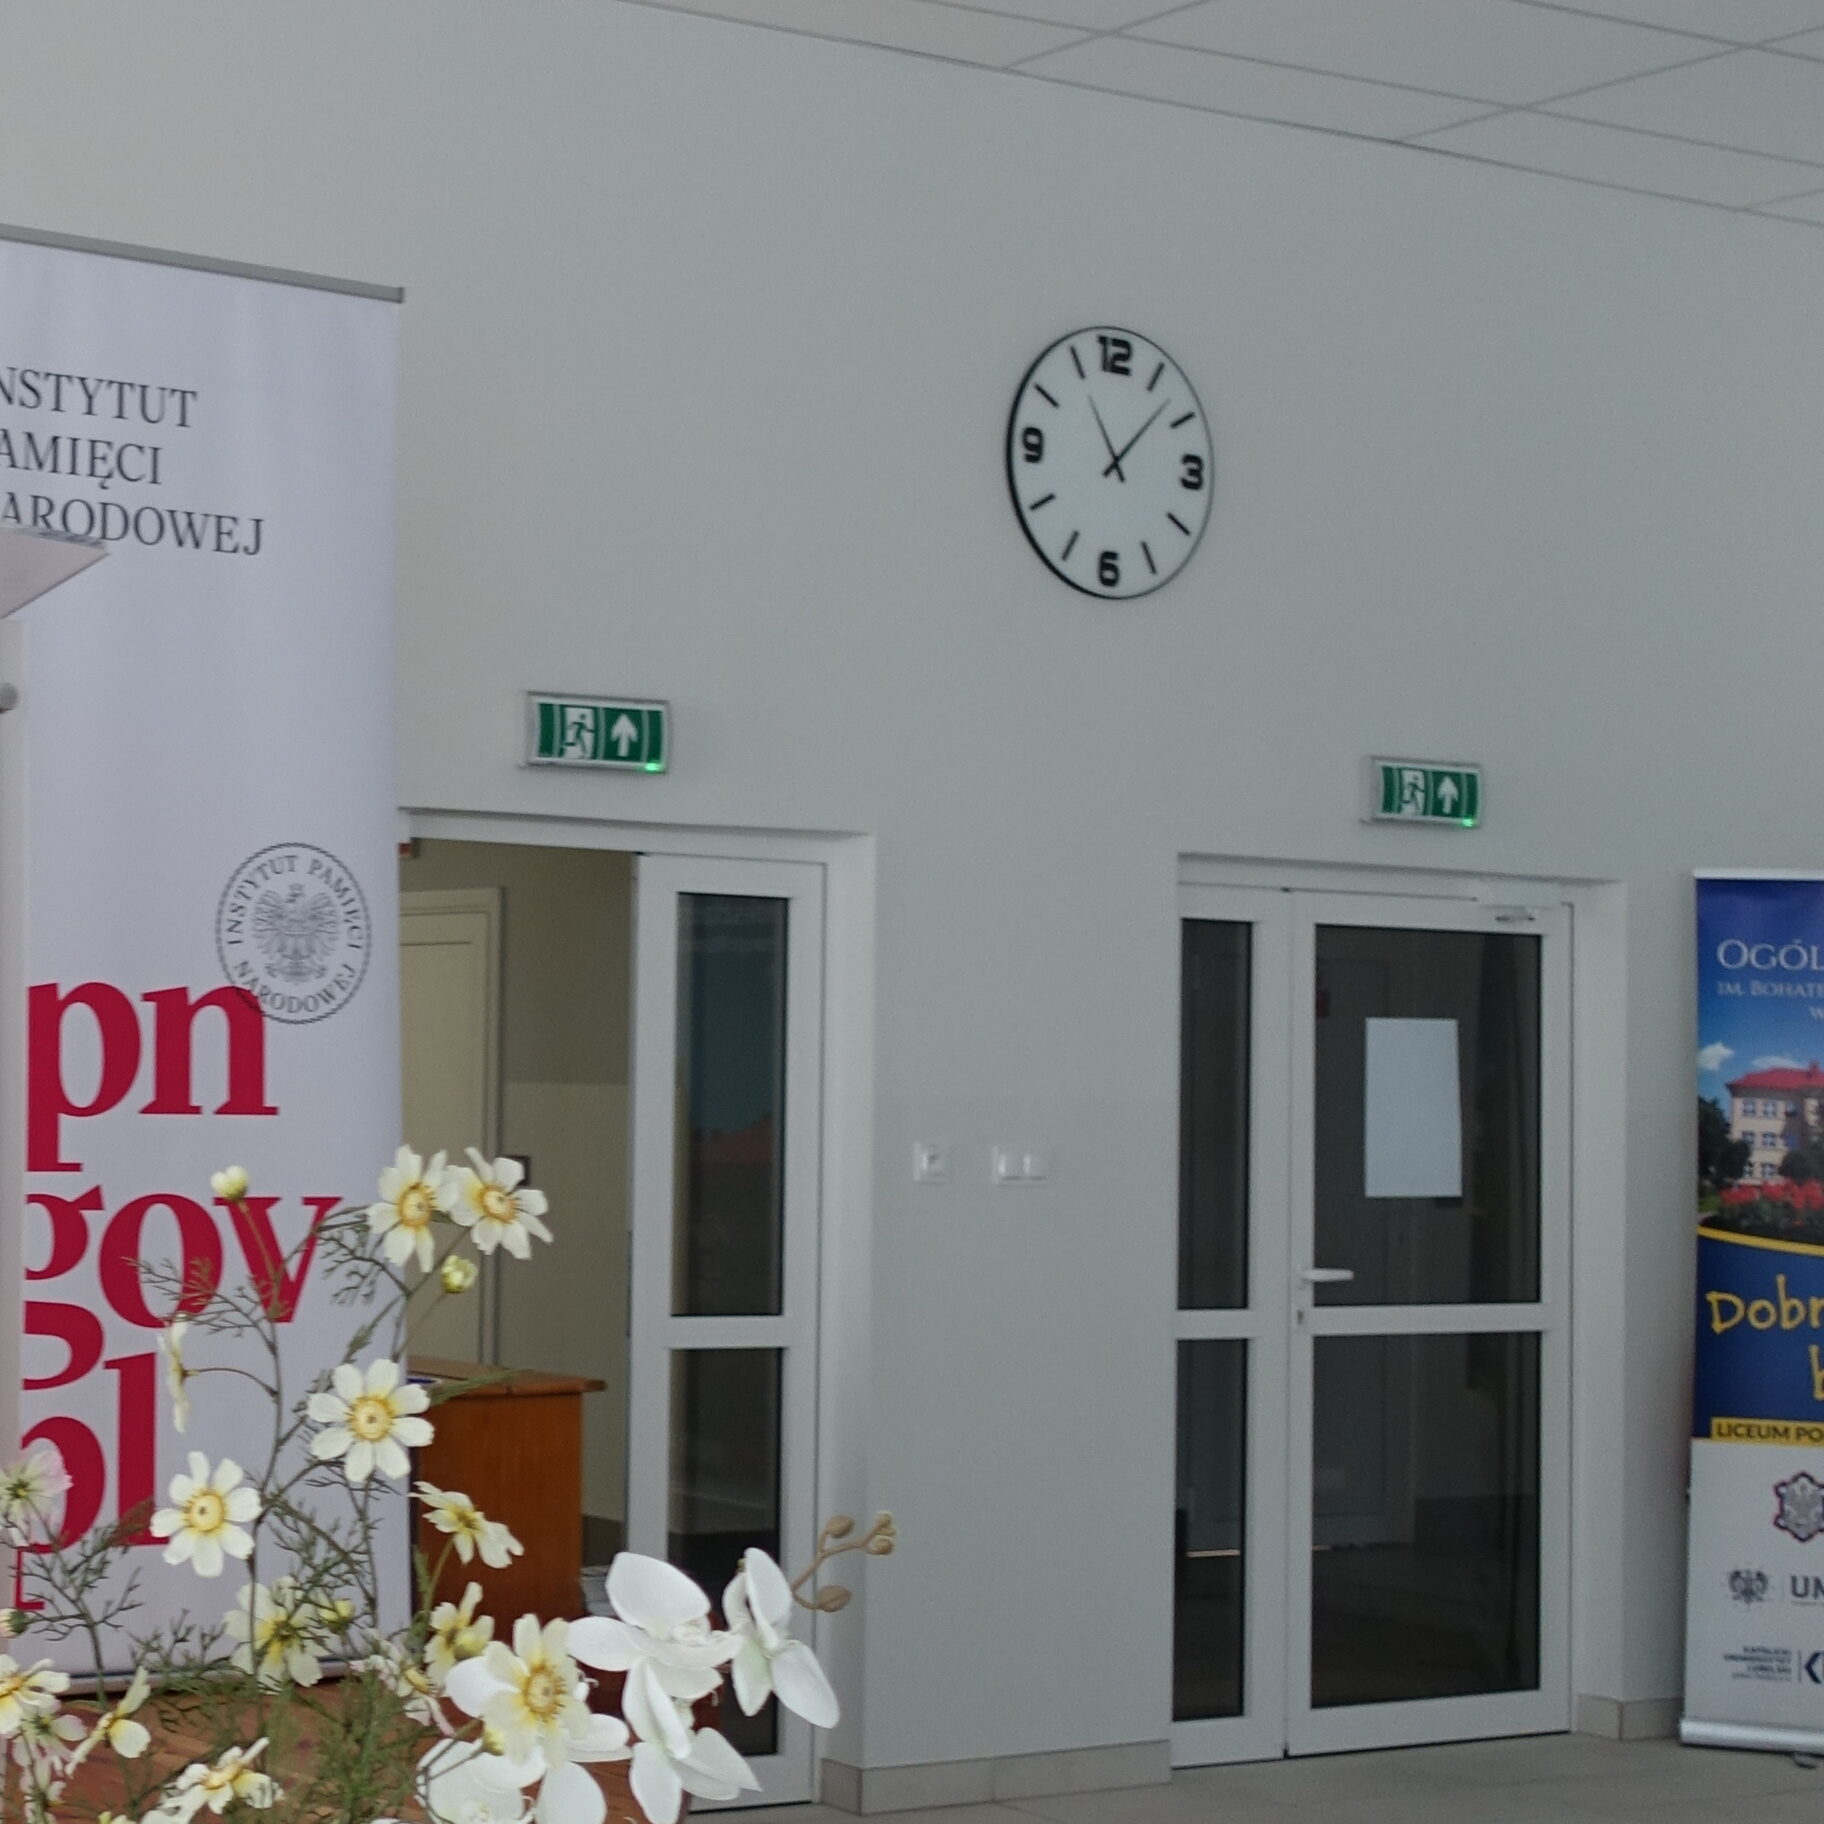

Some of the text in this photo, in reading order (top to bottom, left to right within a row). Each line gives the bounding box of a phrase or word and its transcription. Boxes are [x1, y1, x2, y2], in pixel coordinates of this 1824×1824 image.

[1098, 334, 1133, 376] 12
[1022, 426, 1044, 464] 9
[1180, 454, 1205, 491] 3
[1098, 550, 1121, 587] 6
[227, 855, 297, 944] INSTYTUT
[1717, 1421, 1791, 1440] LICEUM
